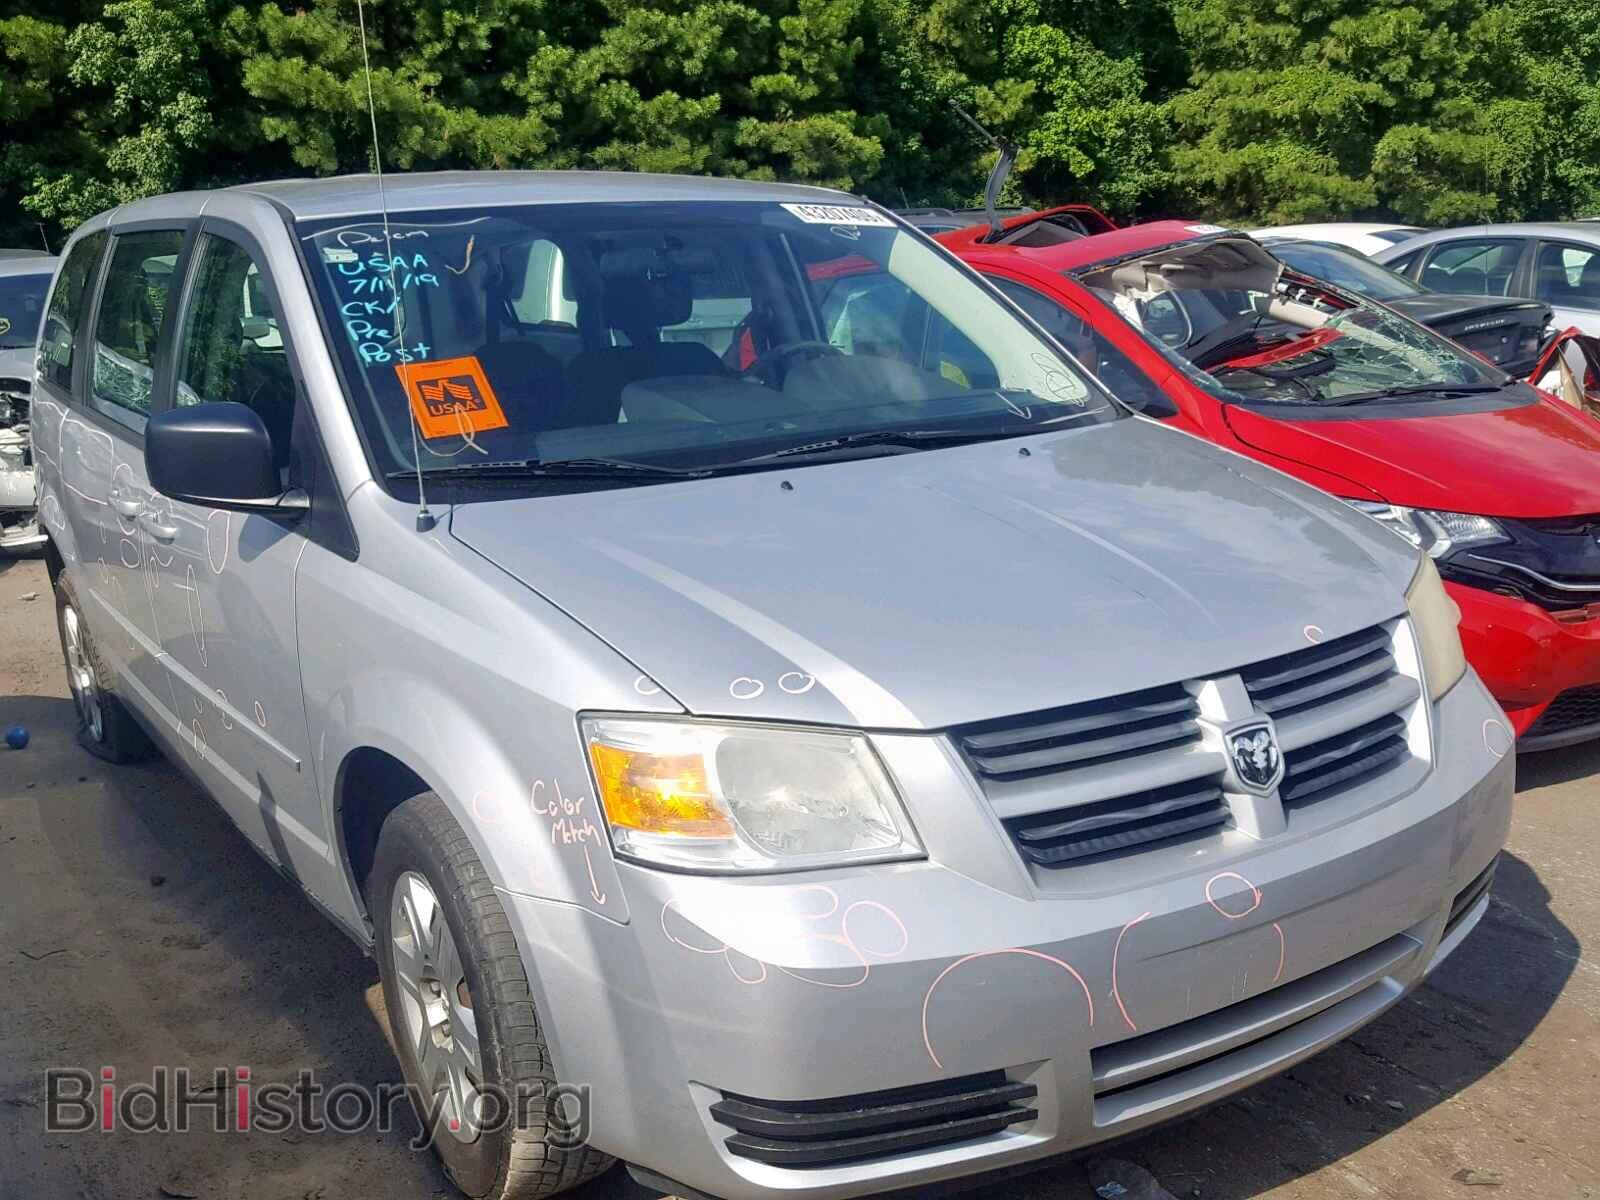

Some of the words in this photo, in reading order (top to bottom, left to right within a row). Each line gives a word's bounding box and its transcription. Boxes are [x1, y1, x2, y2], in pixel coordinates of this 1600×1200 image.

[338, 254, 429, 276] USAA
[346, 320, 393, 341] Pre
[358, 342, 431, 363] Post
[530, 777, 584, 817] Color
